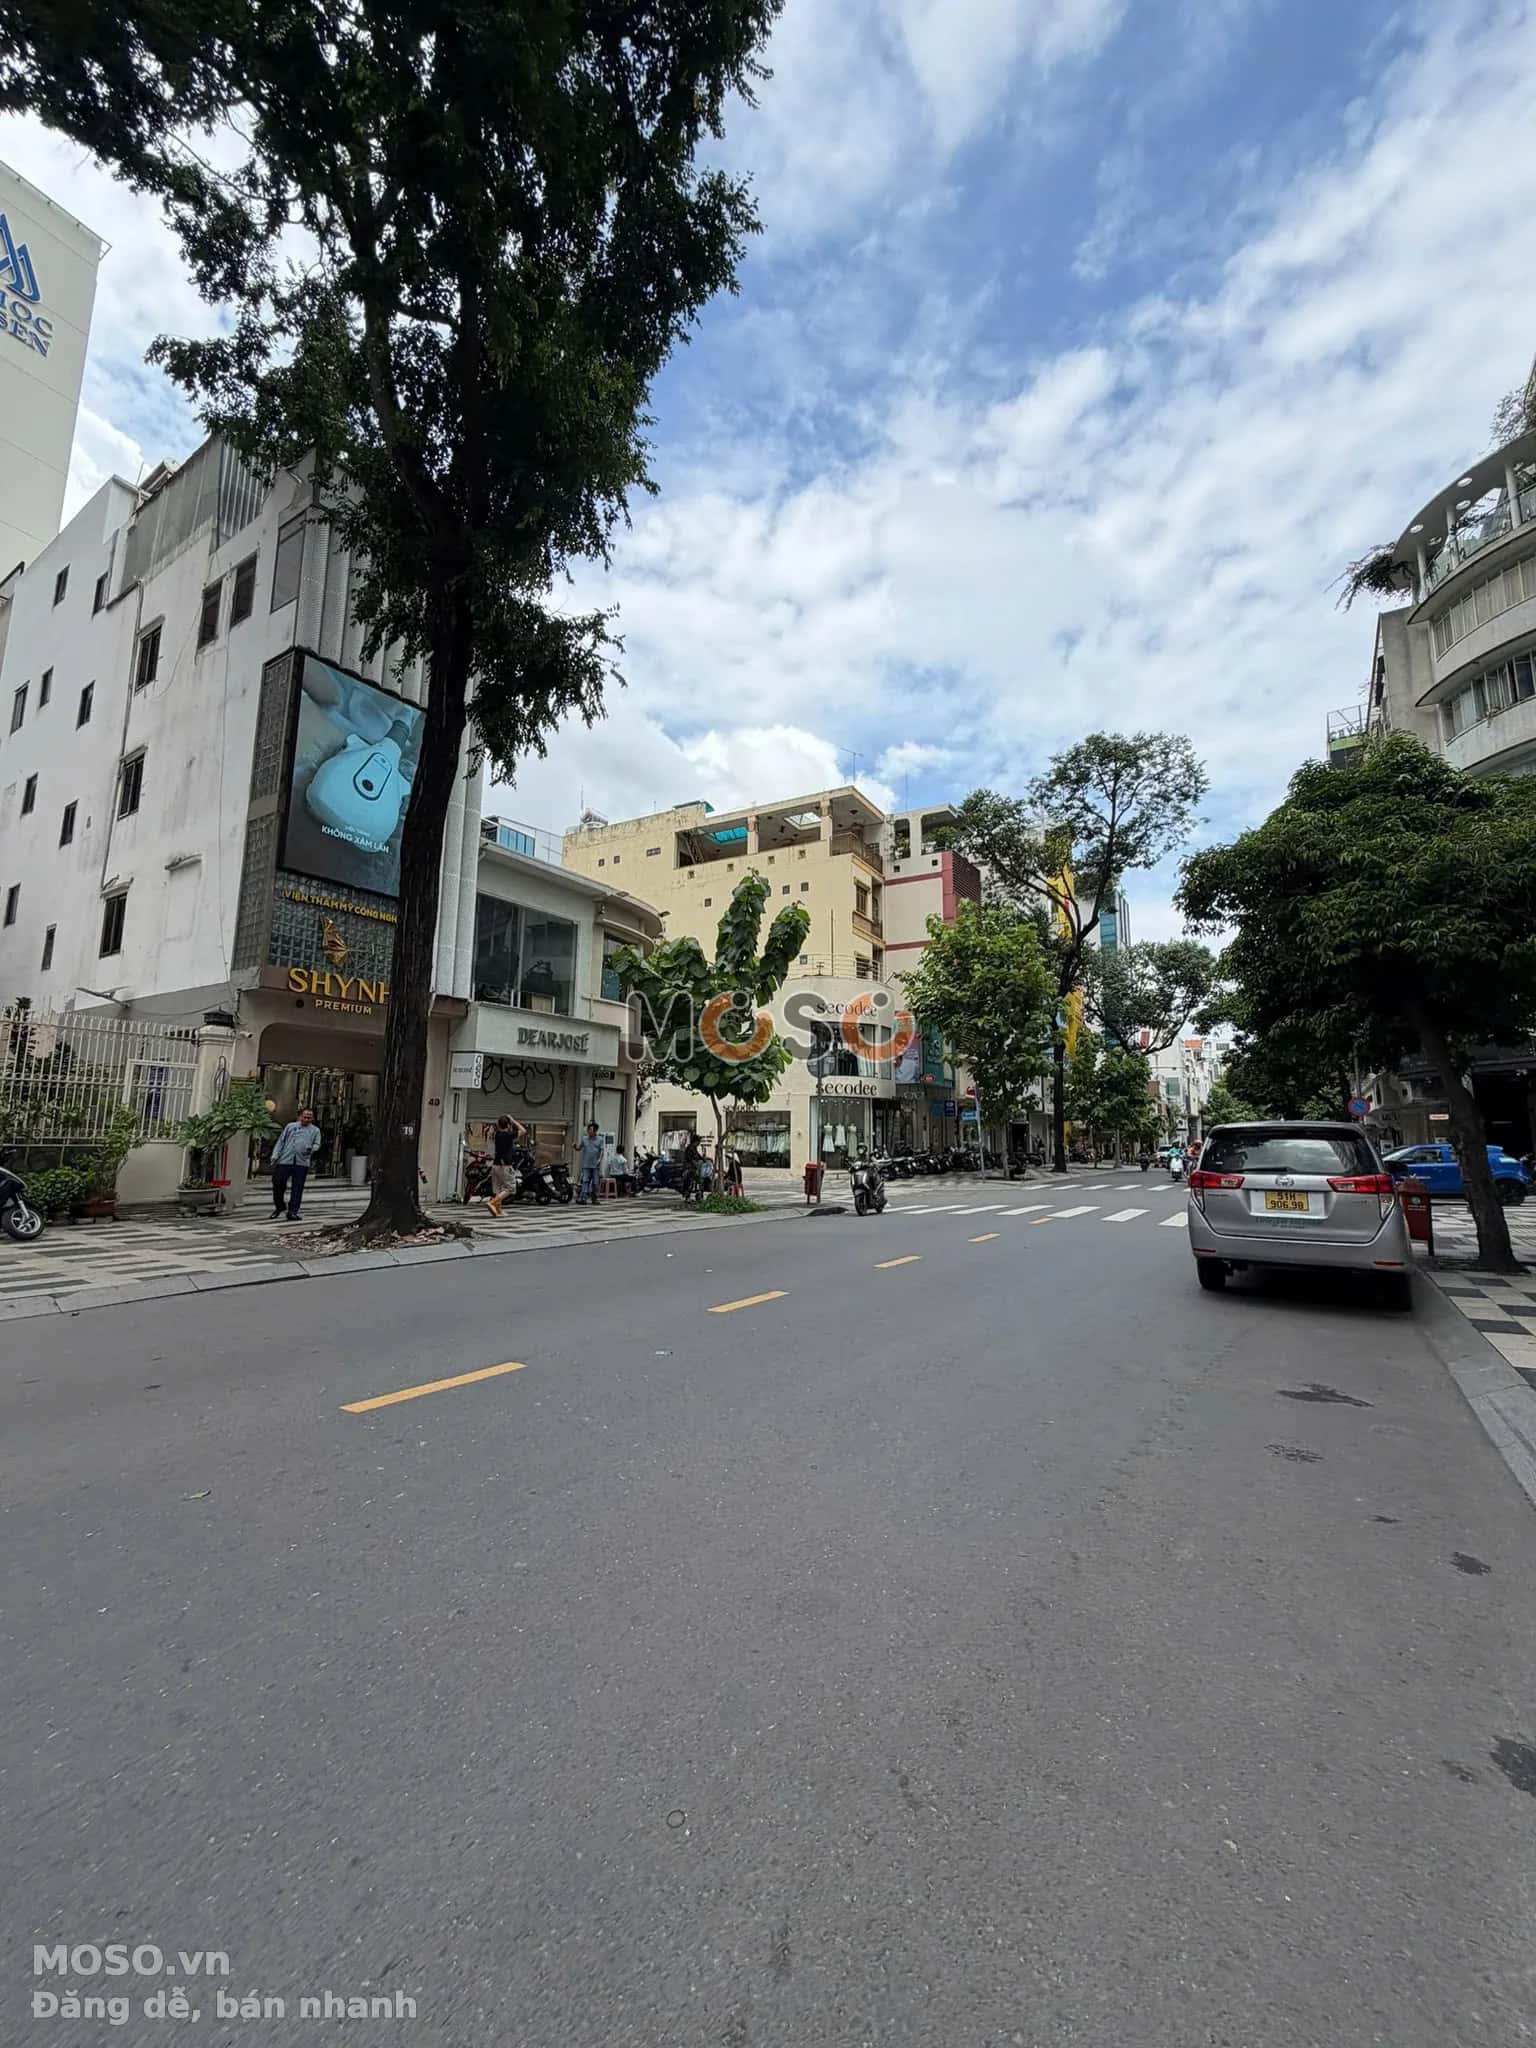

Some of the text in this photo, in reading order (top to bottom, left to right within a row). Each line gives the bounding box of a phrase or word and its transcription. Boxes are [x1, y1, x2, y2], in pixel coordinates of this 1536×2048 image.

[321, 824, 352, 842] KHÔNG
[354, 904, 378, 918] CÔNG
[315, 999, 372, 1015] PREMIUM
[816, 1001, 878, 1017] secodee
[816, 1079, 878, 1096] secodee
